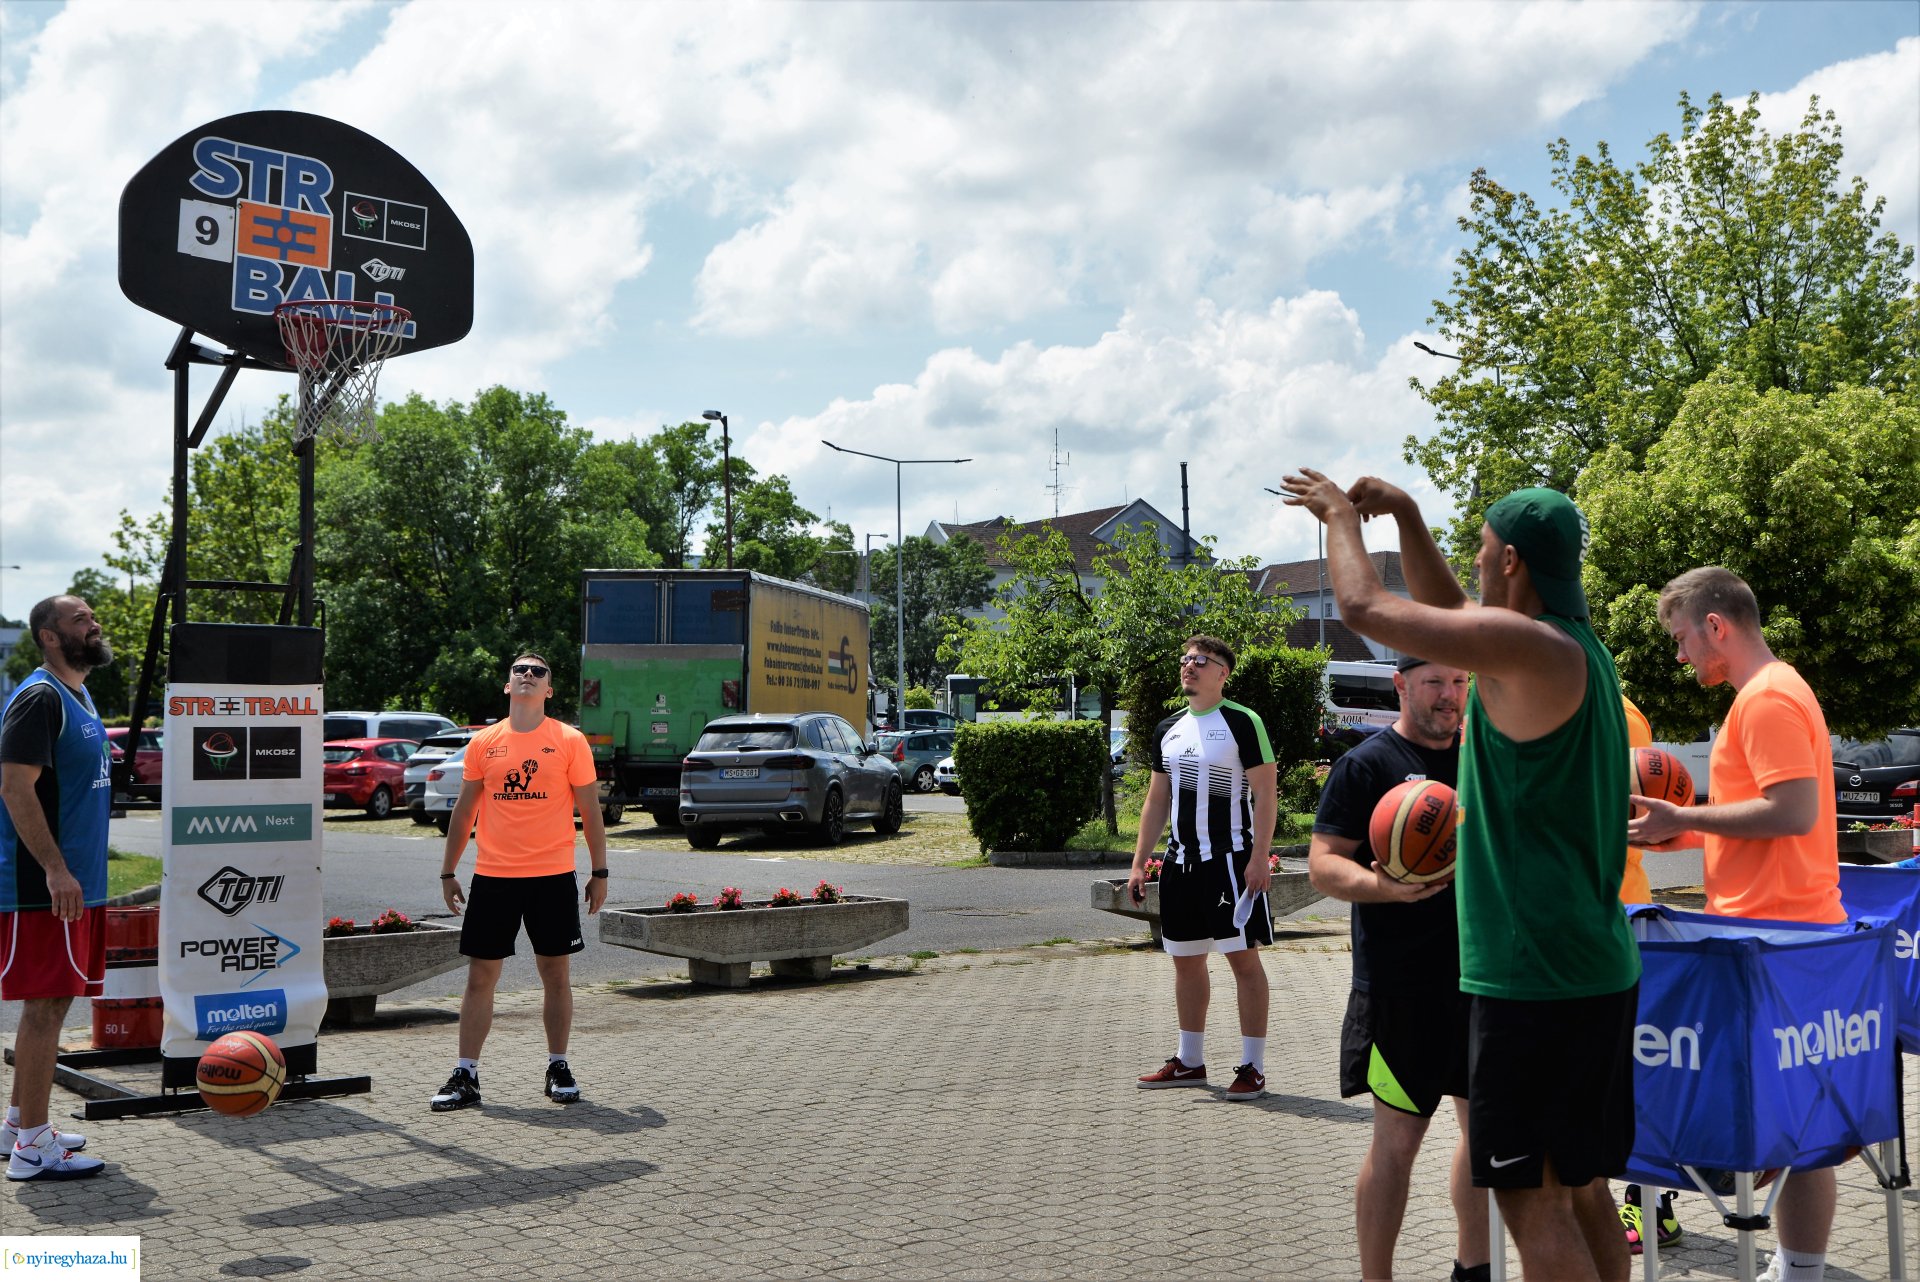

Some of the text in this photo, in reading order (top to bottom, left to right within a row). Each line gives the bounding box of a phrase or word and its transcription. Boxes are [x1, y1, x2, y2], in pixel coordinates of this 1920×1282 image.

[190, 137, 333, 215] STR
[195, 215, 219, 245] 9
[391, 219, 421, 230] MKOSZ
[368, 261, 406, 281] TOTI
[232, 255, 416, 338] BALL
[1341, 715, 1362, 726] AQUA
[1648, 752, 1663, 776] FIBA
[1842, 792, 1879, 802] MUZ-710
[187, 816, 295, 834] MVM Next
[1415, 802, 1440, 836] FIBA
[213, 873, 285, 906] TOTI
[180, 936, 280, 958] POWER
[221, 953, 277, 972] ADE
[207, 1004, 277, 1023] molten
[105, 1023, 129, 1034] 50 L
[206, 1020, 276, 1034] For the real game
[1773, 1009, 1880, 1071] molten
